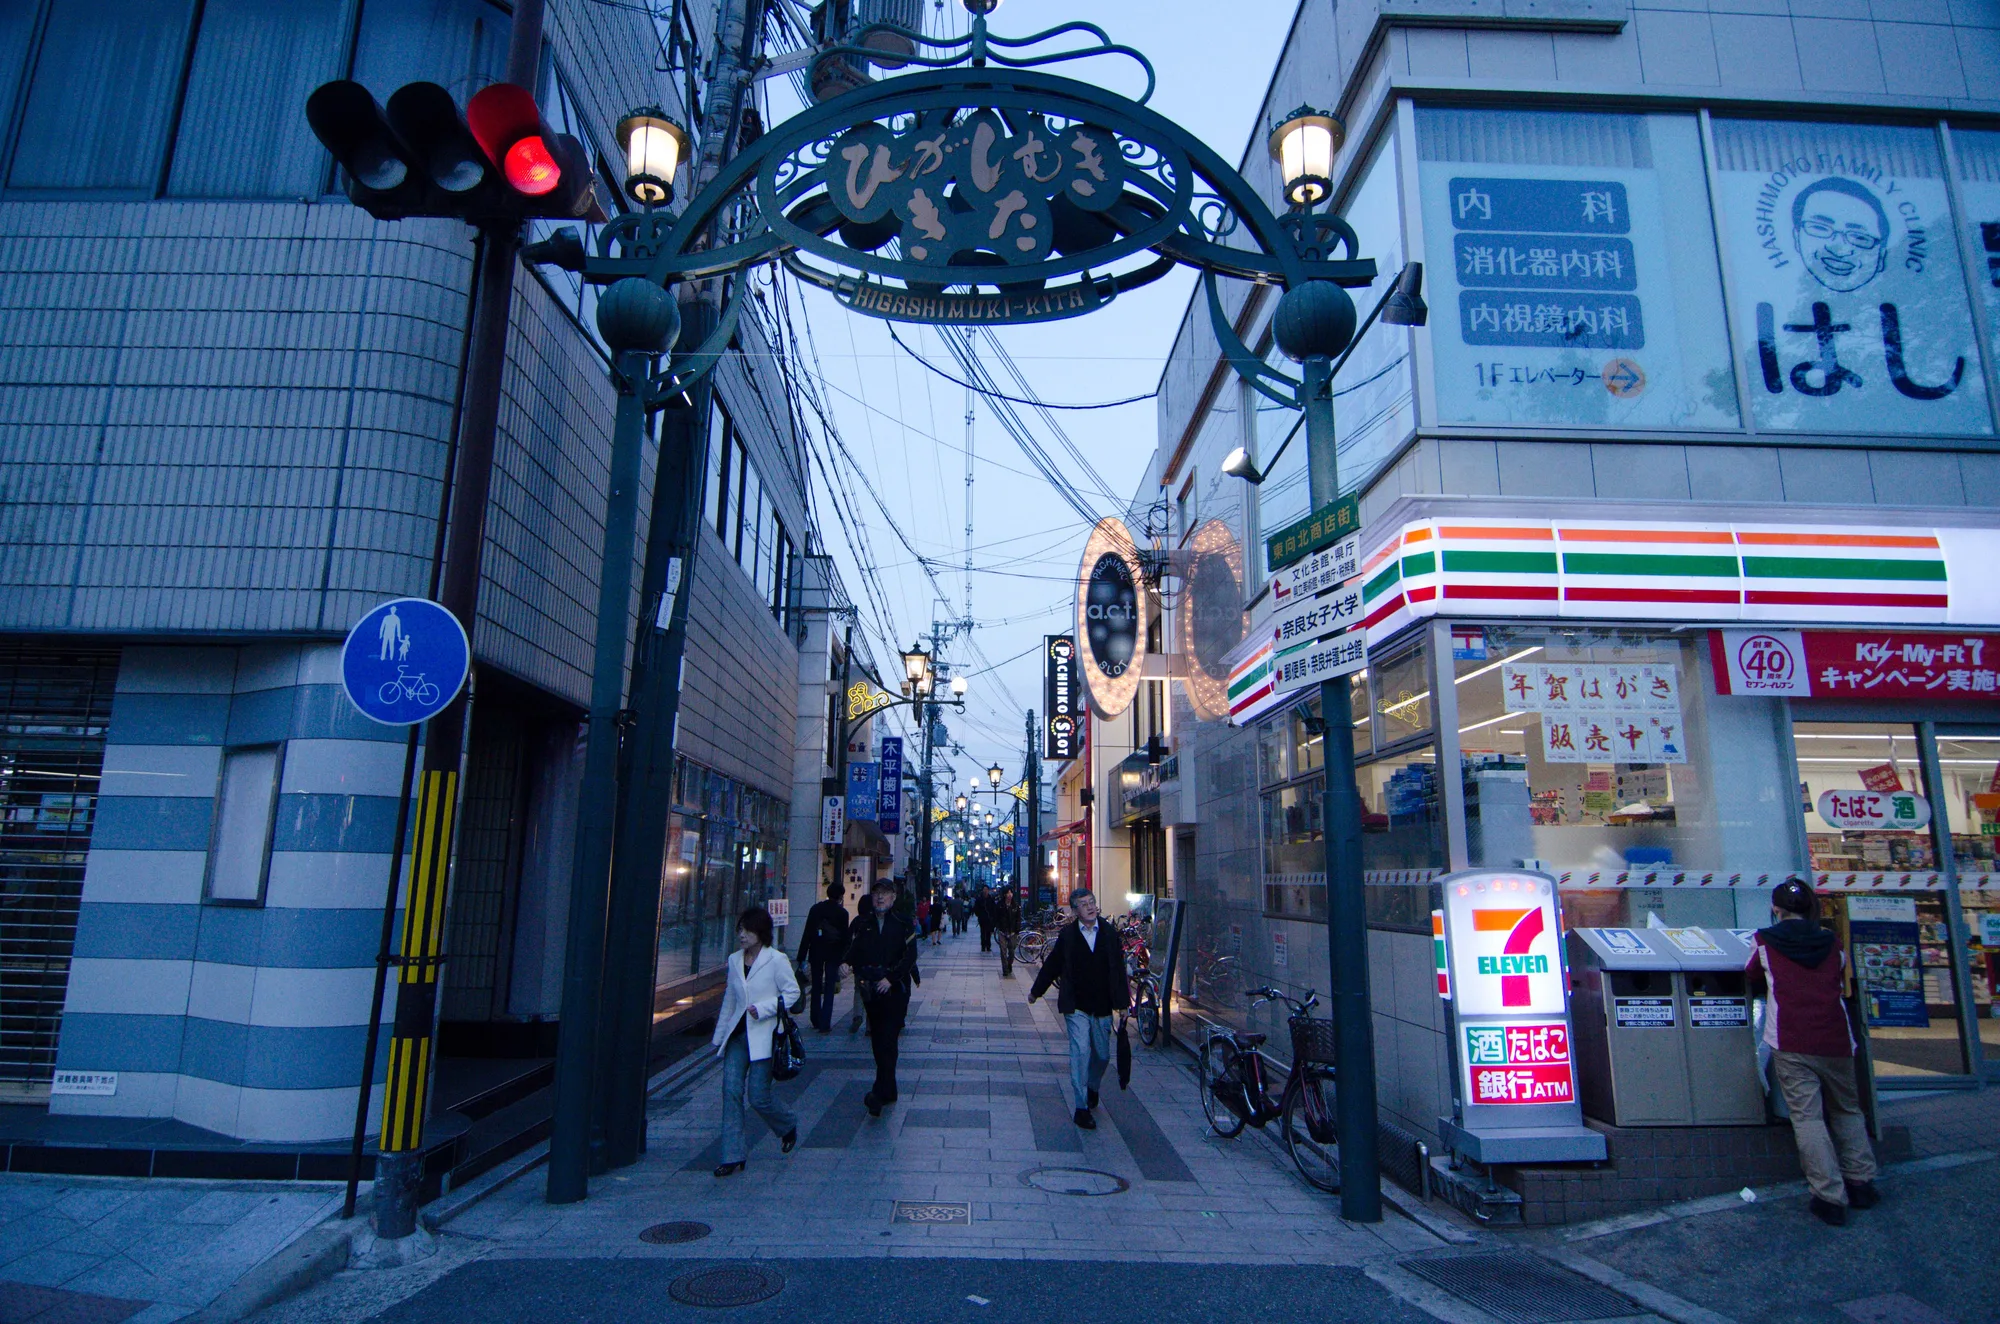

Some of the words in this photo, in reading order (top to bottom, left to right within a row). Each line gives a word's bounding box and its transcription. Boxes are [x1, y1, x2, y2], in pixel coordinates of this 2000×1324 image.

[841, 121, 1108, 210] ひがしむき
[907, 187, 1039, 262] きた
[1756, 157, 1812, 269] HASHIMOTO
[1818, 153, 1901, 195] FAMILY
[1898, 201, 1927, 273] CLINIC
[1464, 245, 1624, 281] 消化器内科
[855, 286, 1085, 320] HIGASHIMUKI-KITA
[1470, 303, 1632, 337] 内視鏡内科
[1756, 301, 1965, 400] はし
[1473, 362, 1504, 387] 1F
[1508, 364, 1603, 385] エレベーター
[1273, 505, 1350, 561] 東向北商店街
[1282, 593, 1359, 640] 奈良女子大学
[1099, 660, 1128, 676] SLOT
[1284, 639, 1363, 682] 郵便局・奈良弁護士会館
[1746, 650, 1785, 679] 40
[1055, 646, 1070, 714] PACHINKO
[1508, 673, 1671, 702] 年賀はがき
[1055, 722, 1069, 756] SLOT
[1549, 724, 1644, 752] 販売中
[882, 741, 898, 810] 木平歯科
[1831, 795, 1884, 819] たばこ
[1892, 796, 1917, 820] 酒
[1472, 906, 1544, 1006] 7
[1470, 1029, 1504, 1063] 酒
[1508, 1028, 1567, 1062] たばこ
[1478, 1070, 1534, 1100] 銀行
[1533, 1081, 1568, 1097] ATM
